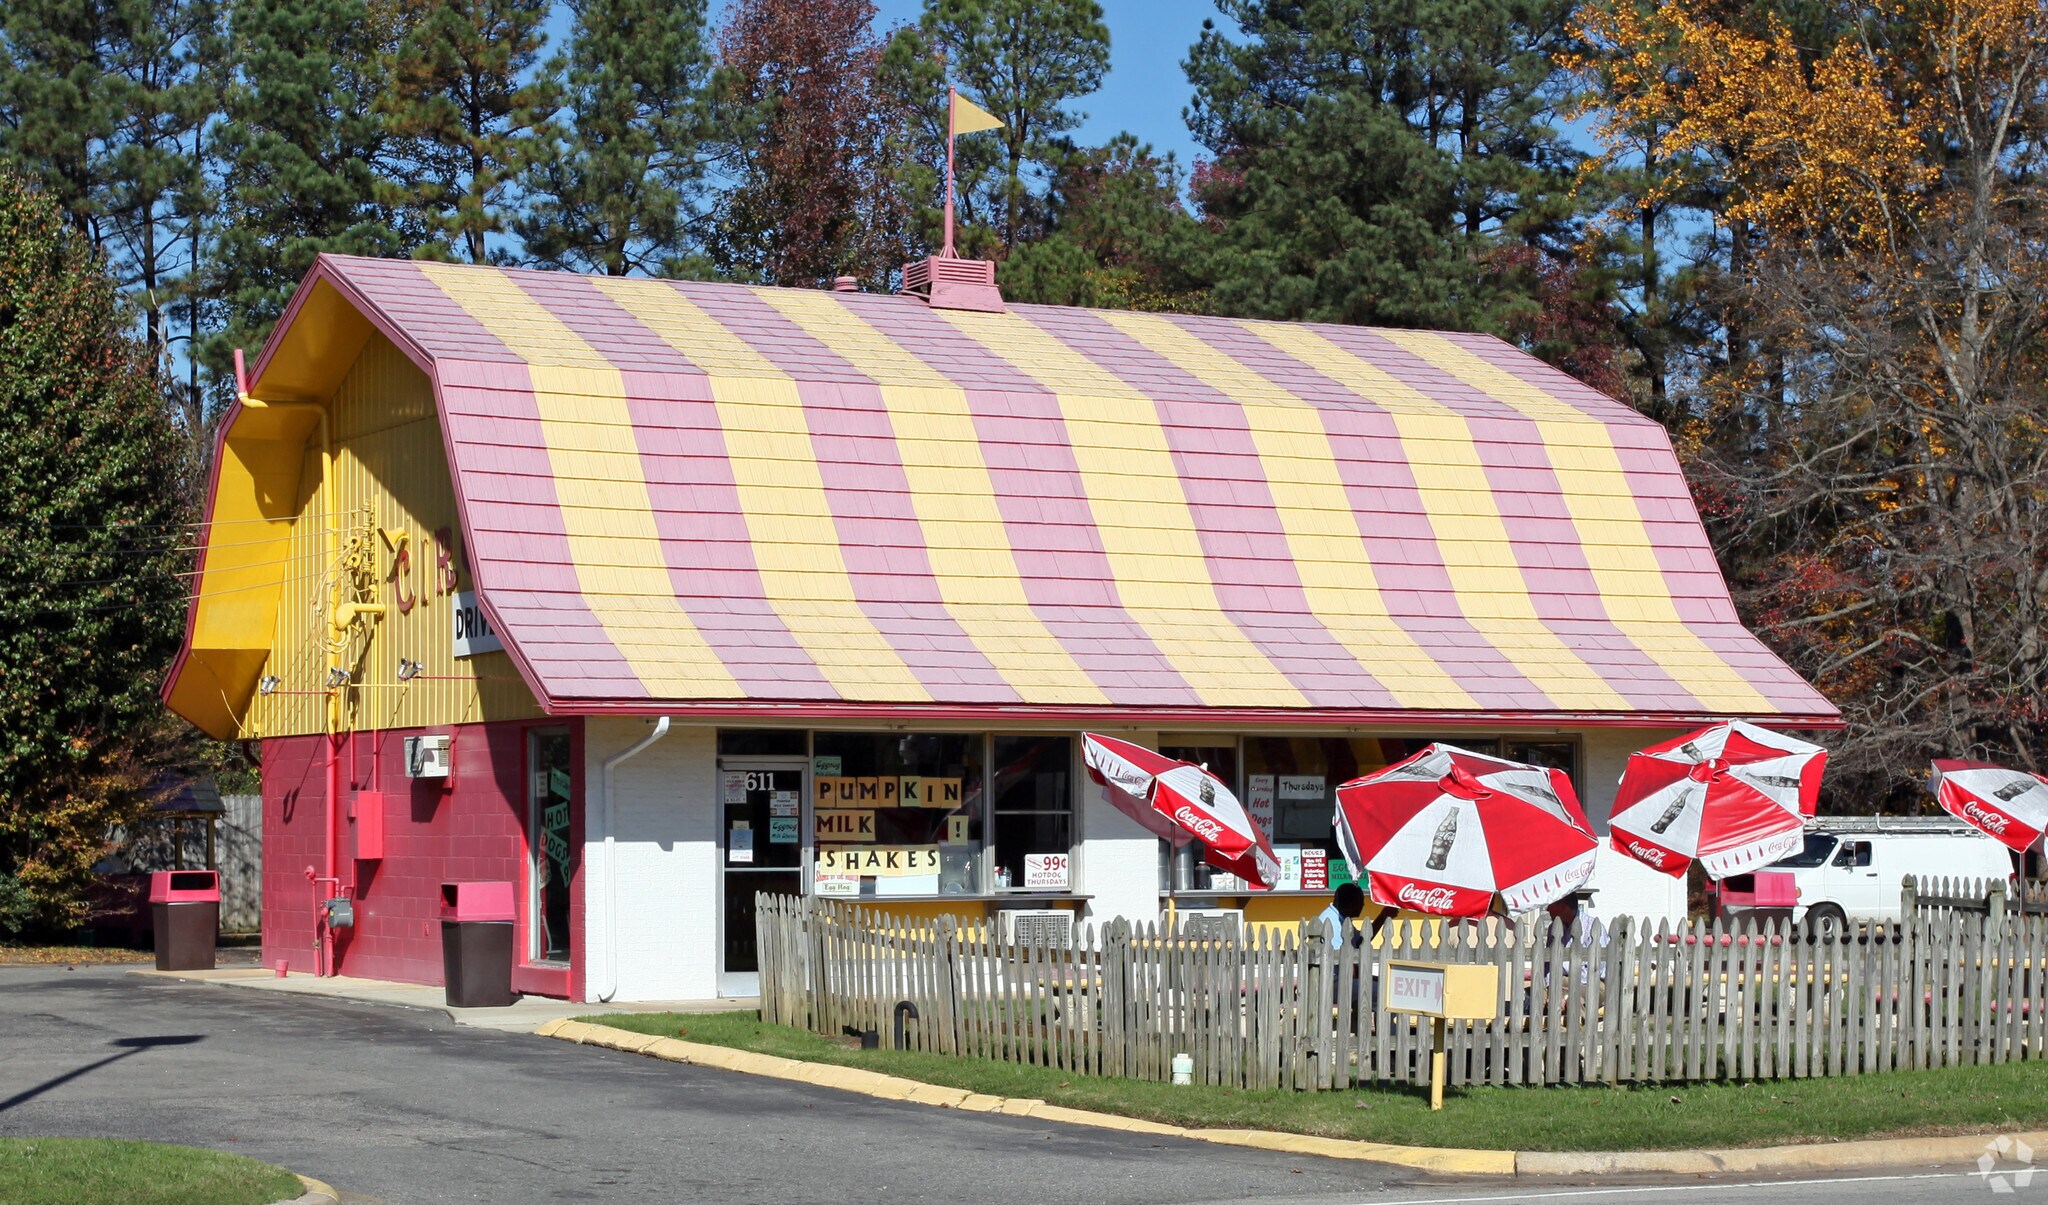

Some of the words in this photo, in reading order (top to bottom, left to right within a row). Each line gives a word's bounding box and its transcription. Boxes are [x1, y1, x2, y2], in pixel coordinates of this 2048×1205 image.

[456, 606, 495, 640] DRIV
[744, 772, 775, 791] 611
[820, 782, 959, 802] PUMPKIN
[1283, 781, 1324, 793] Thursdays
[1253, 798, 1270, 808] Hot
[547, 808, 567, 828] HOT
[816, 815, 872, 834] MILK
[955, 821, 961, 838] !
[1174, 806, 1224, 843] Coca-Cola
[1963, 801, 2012, 836] Coca-Cola
[541, 832, 567, 860] DOGS
[1629, 841, 1664, 868] Coca-Cola
[826, 849, 936, 869] SHAKES
[1043, 856, 1067, 871] 99¢
[1398, 883, 1457, 910] Coca-Cola
[1394, 976, 1431, 998] EXIT
